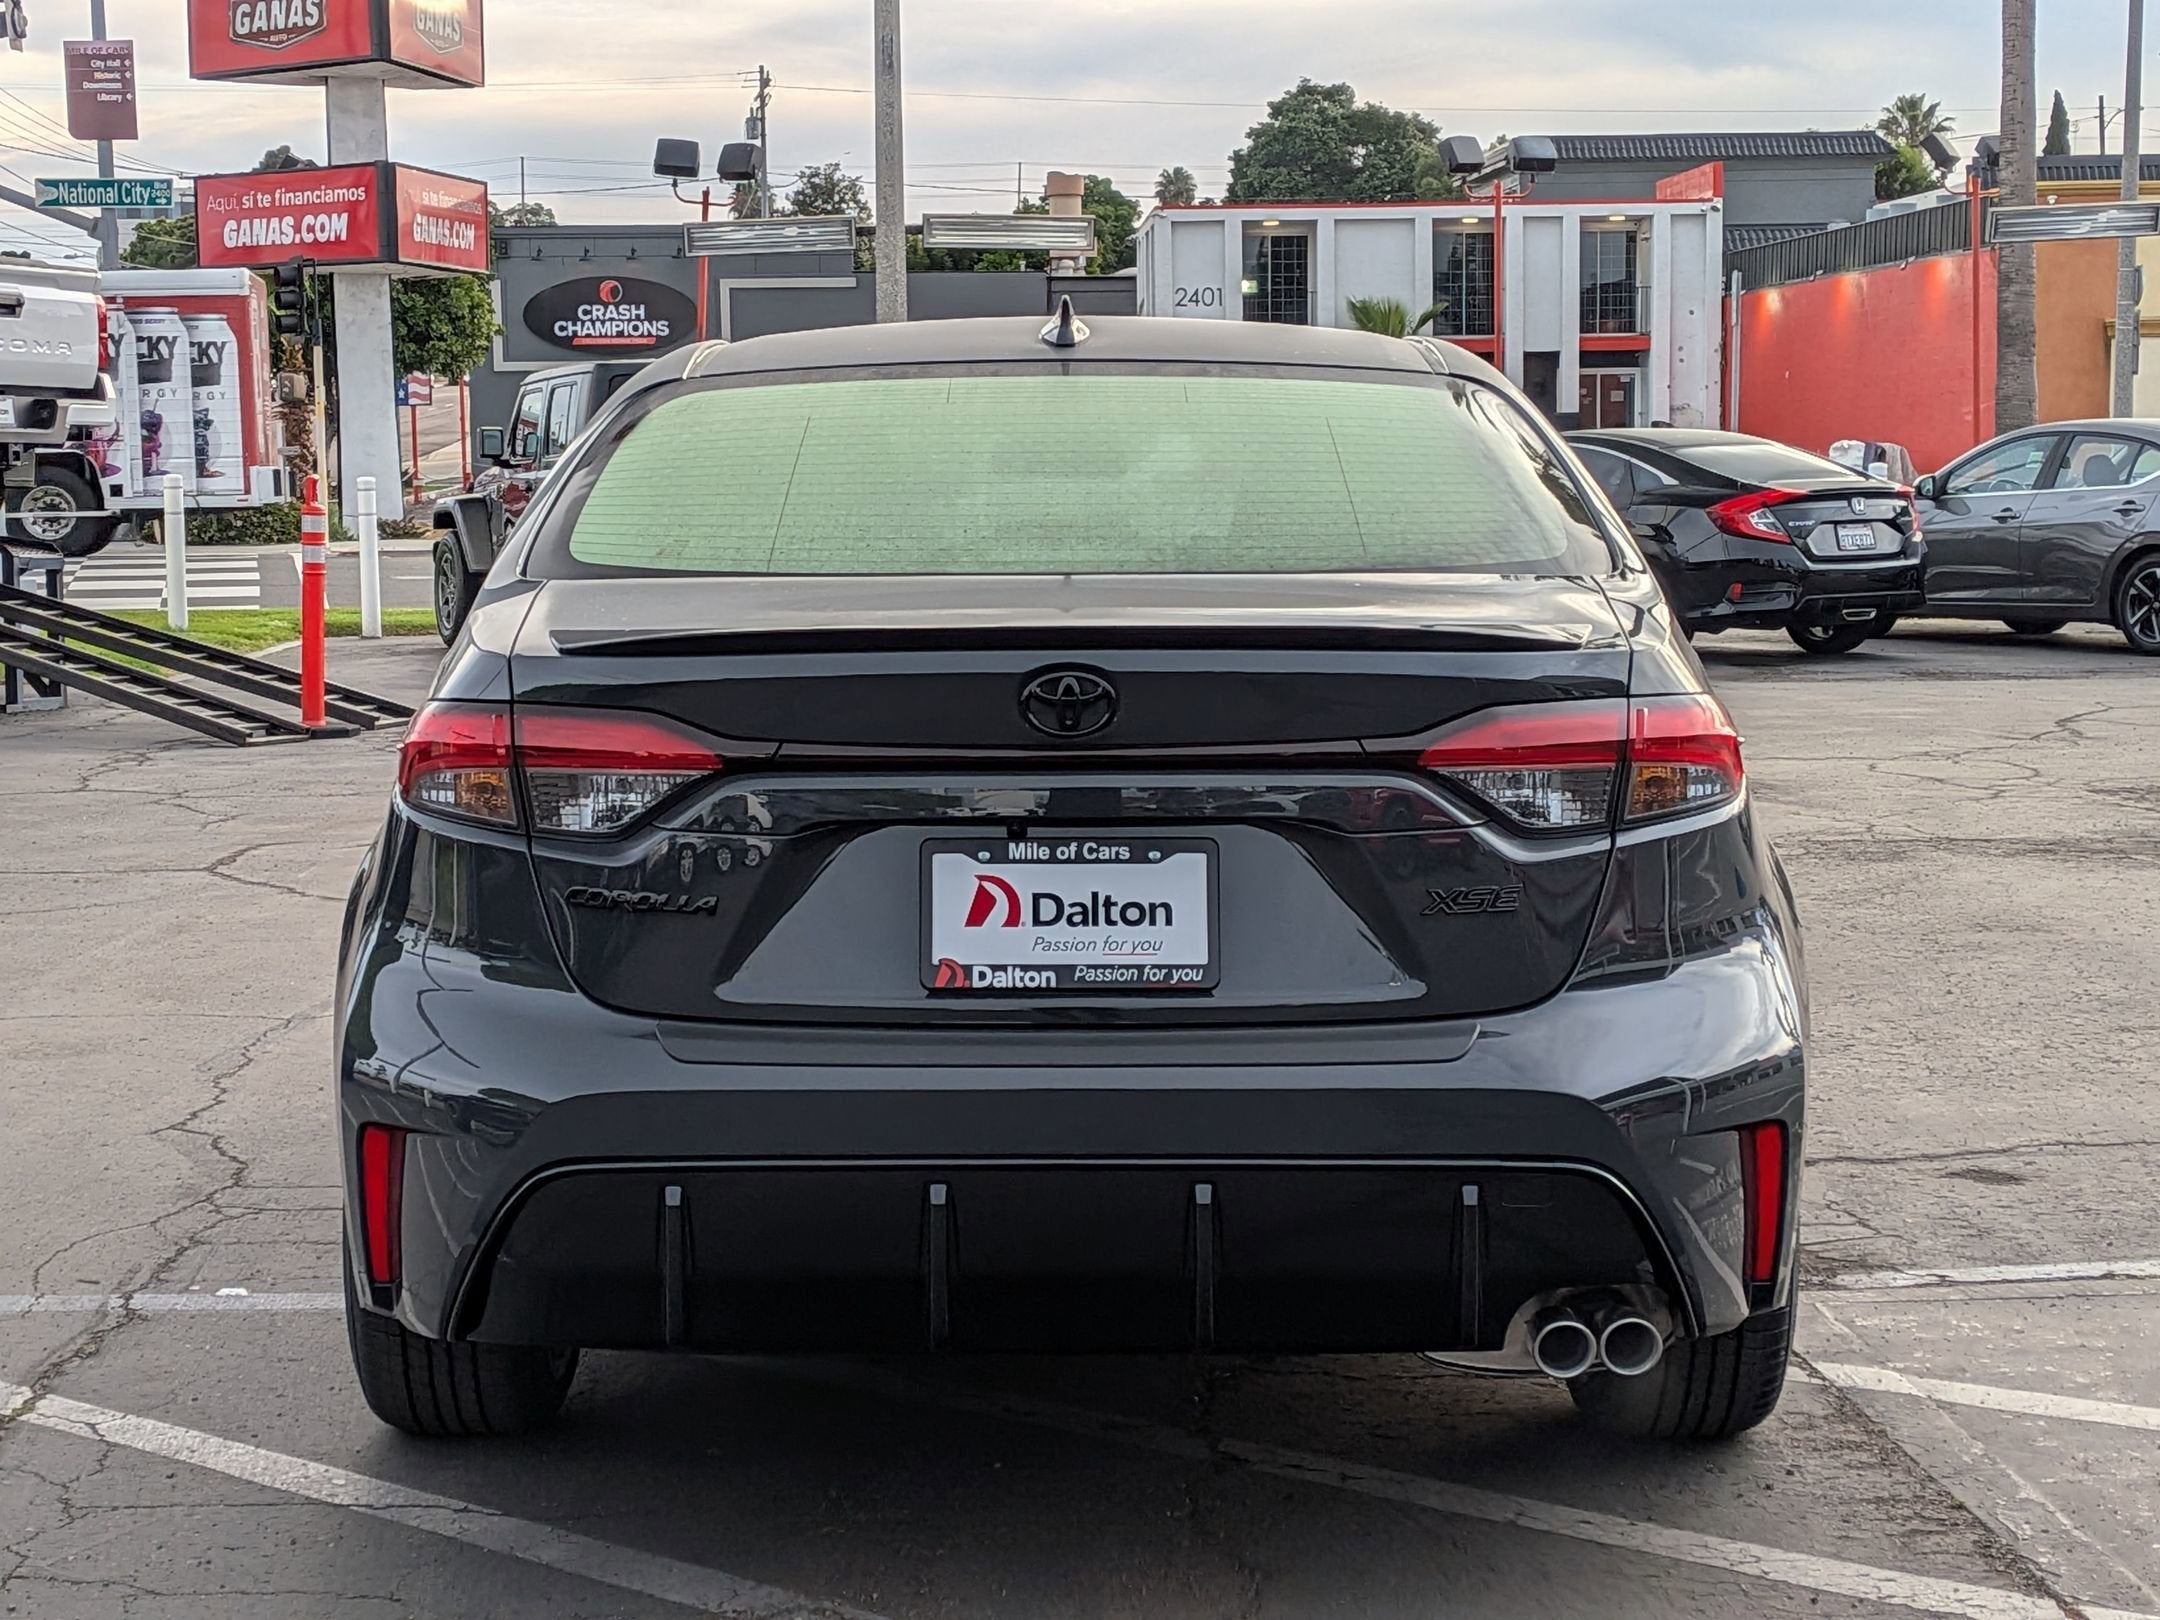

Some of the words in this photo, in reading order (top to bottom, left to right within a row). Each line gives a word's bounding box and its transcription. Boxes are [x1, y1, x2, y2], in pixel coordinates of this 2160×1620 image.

[234, 0, 321, 36] GANAS
[416, 8, 461, 42] GANAS
[270, 33, 288, 42] AUTO
[96, 92, 123, 103] Library
[58, 182, 119, 204] National
[121, 182, 151, 206] City
[151, 188, 171, 198] 2400
[206, 193, 240, 213] Aquí,
[241, 190, 256, 209] sí
[256, 190, 272, 208] te
[274, 185, 366, 207] financiamos
[223, 212, 349, 248] GANAS.COM
[413, 212, 475, 252] GANAS.COM
[1175, 287, 1223, 307] 2401
[577, 304, 645, 320] CRASH
[553, 320, 670, 337] CHAMPIONS
[1008, 842, 1050, 860] Mile
[1056, 842, 1077, 860] of
[1082, 842, 1131, 861] Cars
[564, 886, 718, 916] COROLLA
[1031, 891, 1174, 928] Dalton
[1421, 883, 1523, 915] XSE
[1031, 936, 1097, 952] Passion
[1101, 935, 1129, 953] for
[1130, 939, 1163, 953] you
[972, 966, 1057, 988] Dalton
[1073, 966, 1138, 982] Passion
[1141, 965, 1168, 982] for
[1169, 967, 1204, 984] you
